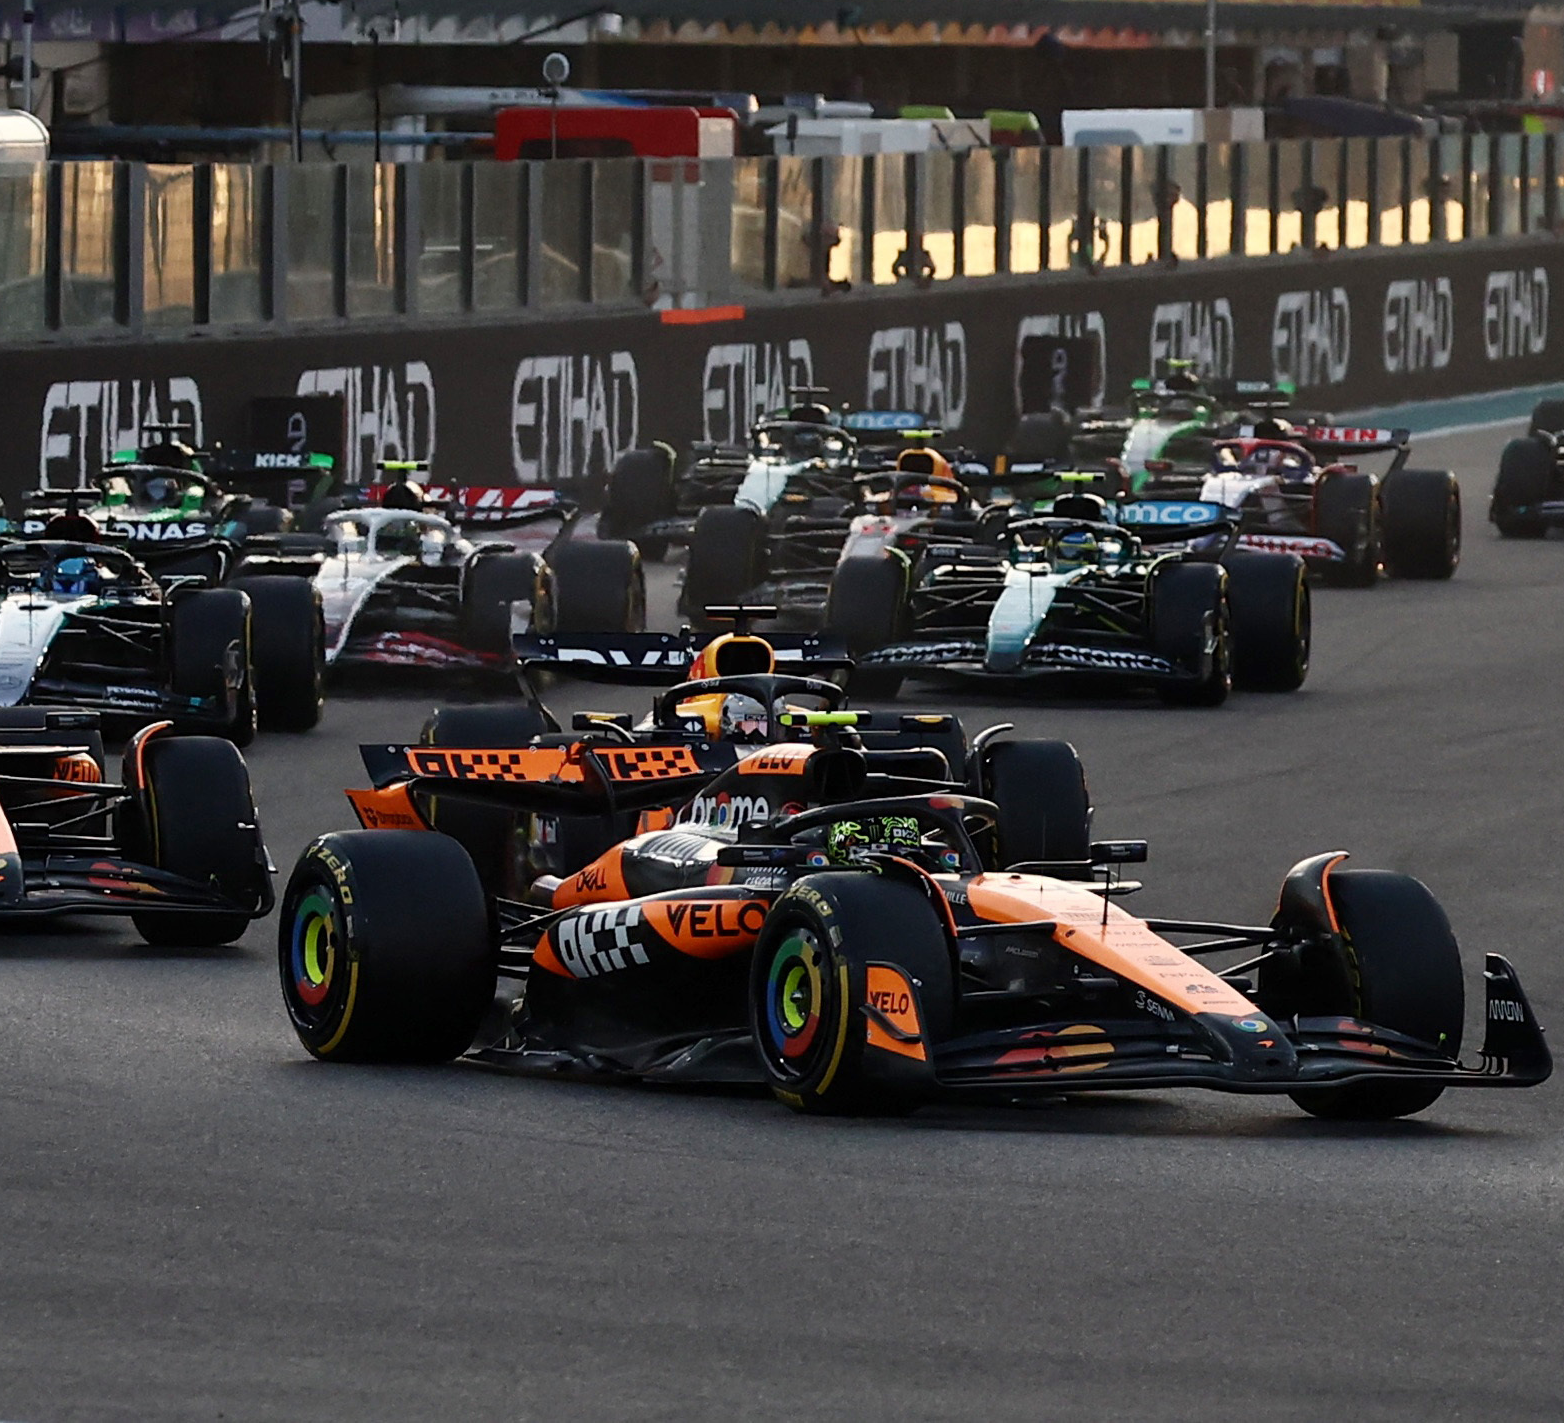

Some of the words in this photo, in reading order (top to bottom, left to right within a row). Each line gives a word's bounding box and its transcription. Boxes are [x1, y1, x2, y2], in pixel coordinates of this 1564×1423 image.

[1383, 277, 1453, 373] ETIHAD
[1484, 267, 1549, 360] ETIHAD
[1272, 287, 1350, 384] ETIHAD
[512, 351, 639, 482] ETIHAD
[255, 453, 302, 468] KICK
[317, 846, 354, 905] ZERO
[576, 868, 607, 893] DELL
[787, 882, 833, 916] ZERO
[667, 903, 767, 936] VELO
[870, 991, 909, 1015] VELO
[1489, 999, 1524, 1022] ARROW
